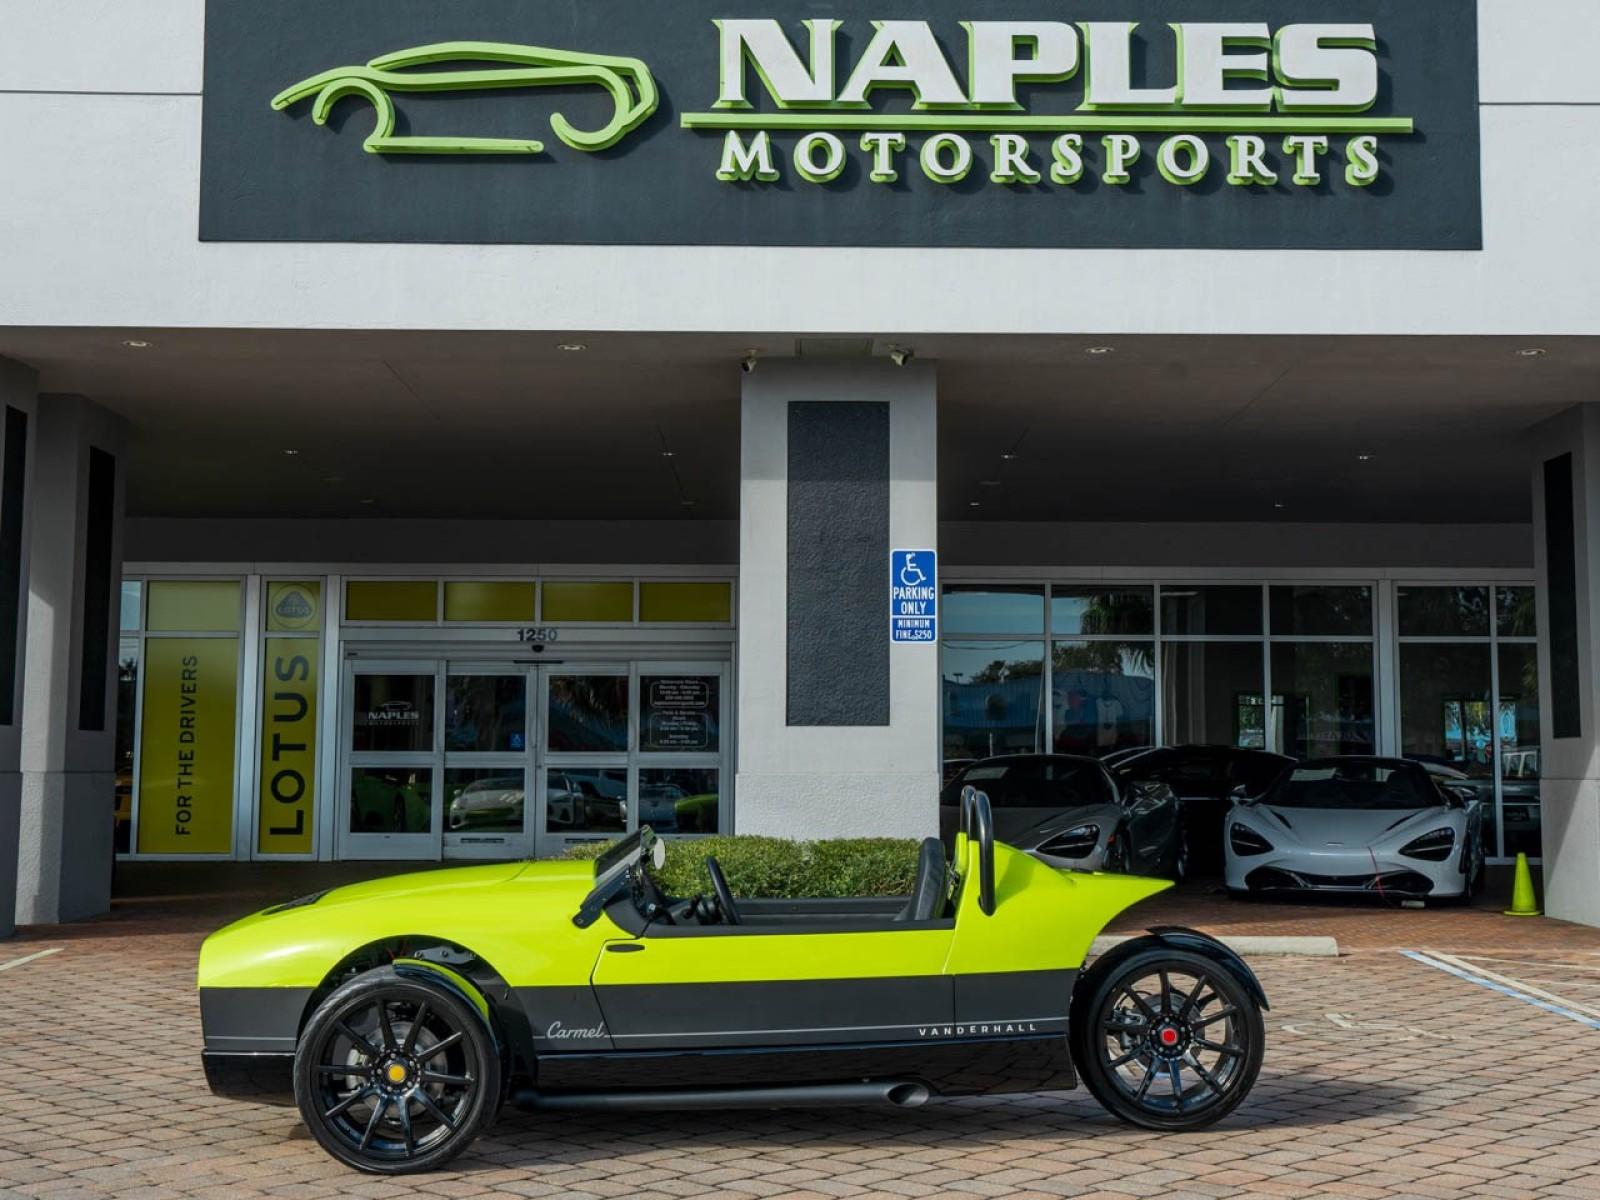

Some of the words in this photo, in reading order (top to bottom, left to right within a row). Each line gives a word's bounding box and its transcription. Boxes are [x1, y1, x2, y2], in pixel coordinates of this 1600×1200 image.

[711, 18, 1378, 112] NAPLES
[715, 130, 1380, 187] MOTORSPORTS
[893, 587, 935, 600] PARKING
[901, 601, 927, 615] ONLY
[898, 619, 931, 629] MINIMUM
[517, 627, 558, 641] 1250
[180, 655, 198, 744] DRIVERS
[368, 711, 420, 720] NAPLES
[269, 654, 310, 836] LOTUS
[177, 750, 194, 790] THE
[175, 795, 192, 835] FOR
[546, 1020, 605, 1039] Carmel
[919, 1023, 1037, 1036] VANDERHALL
